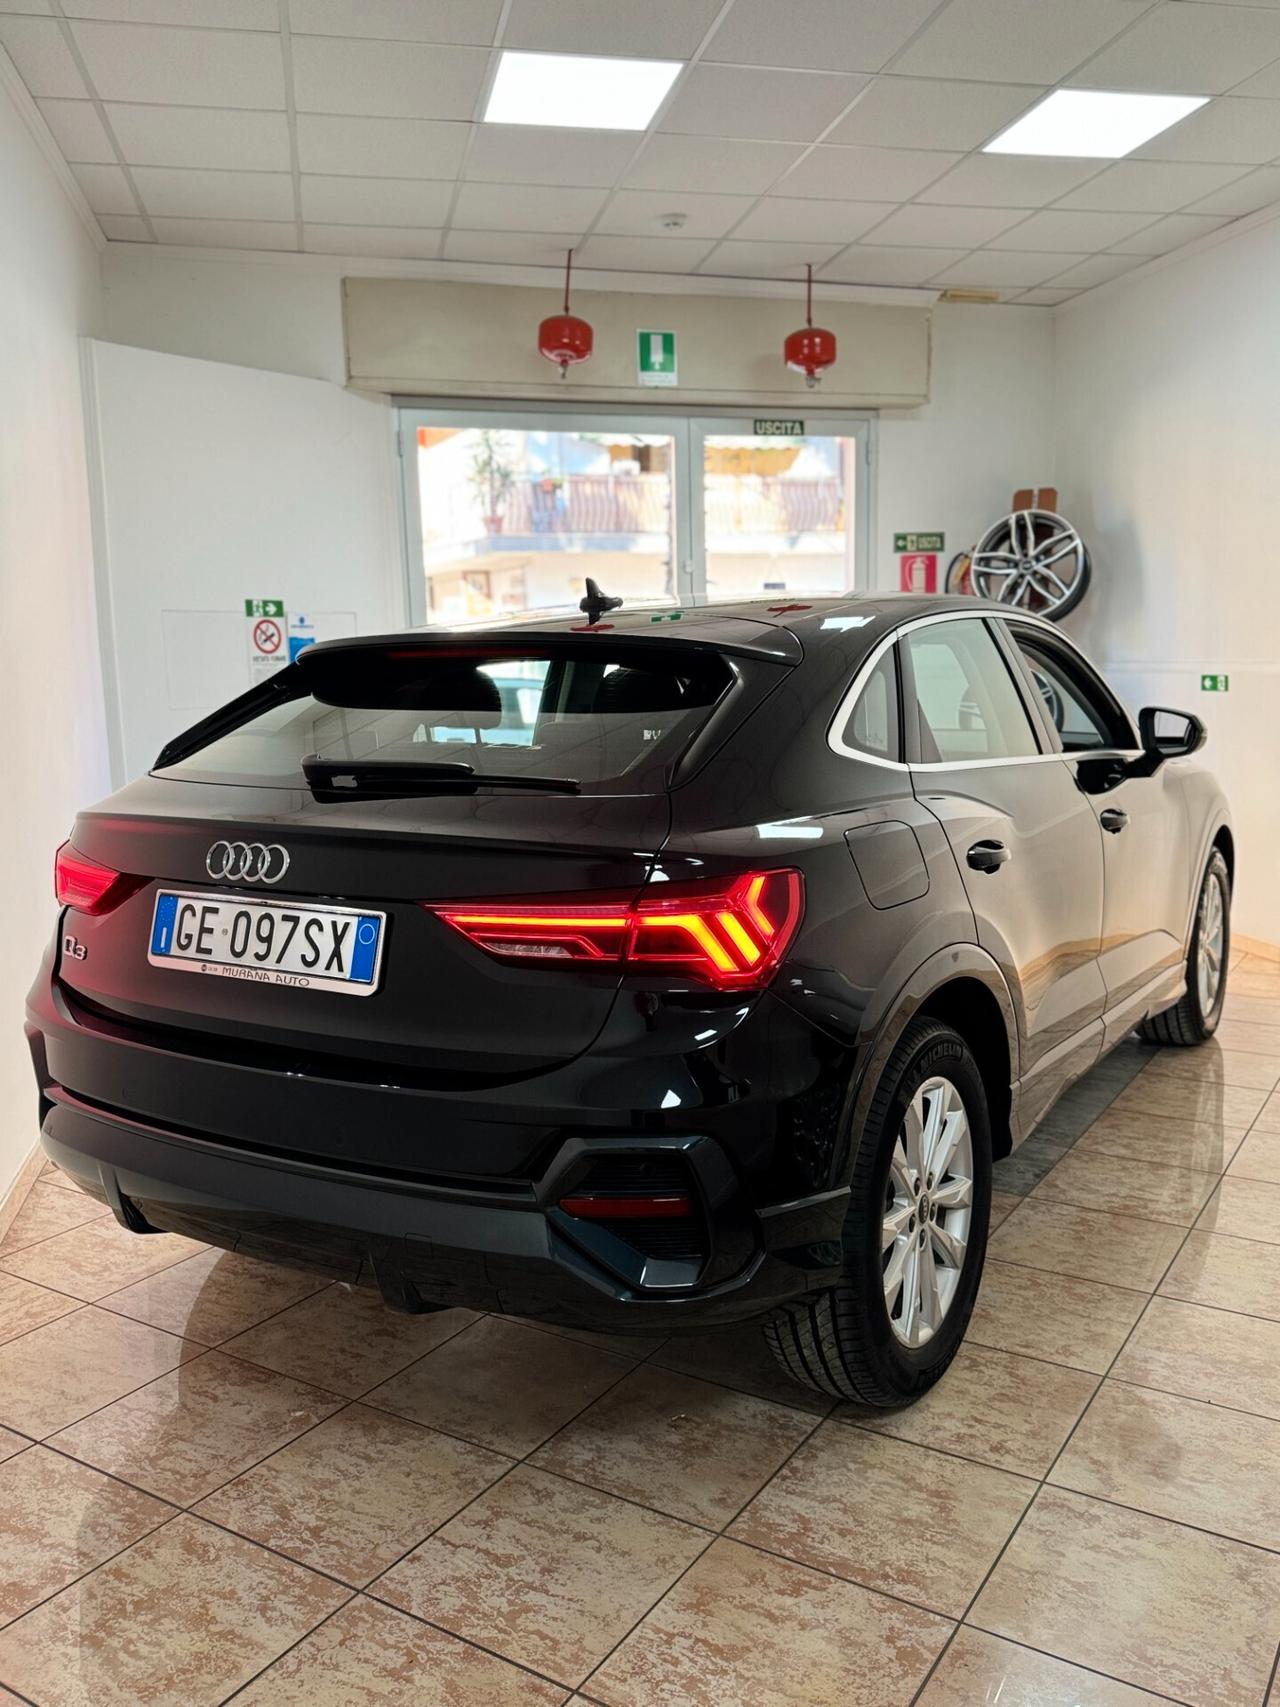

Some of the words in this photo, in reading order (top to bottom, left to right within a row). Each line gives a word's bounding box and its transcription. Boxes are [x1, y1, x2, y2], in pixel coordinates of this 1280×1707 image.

[756, 421, 802, 434] USCITA
[64, 935, 88, 960] Q3
[176, 903, 220, 955] GE
[229, 910, 351, 973] 097SX
[221, 966, 271, 982] MURANA
[275, 973, 310, 987] AUTO
